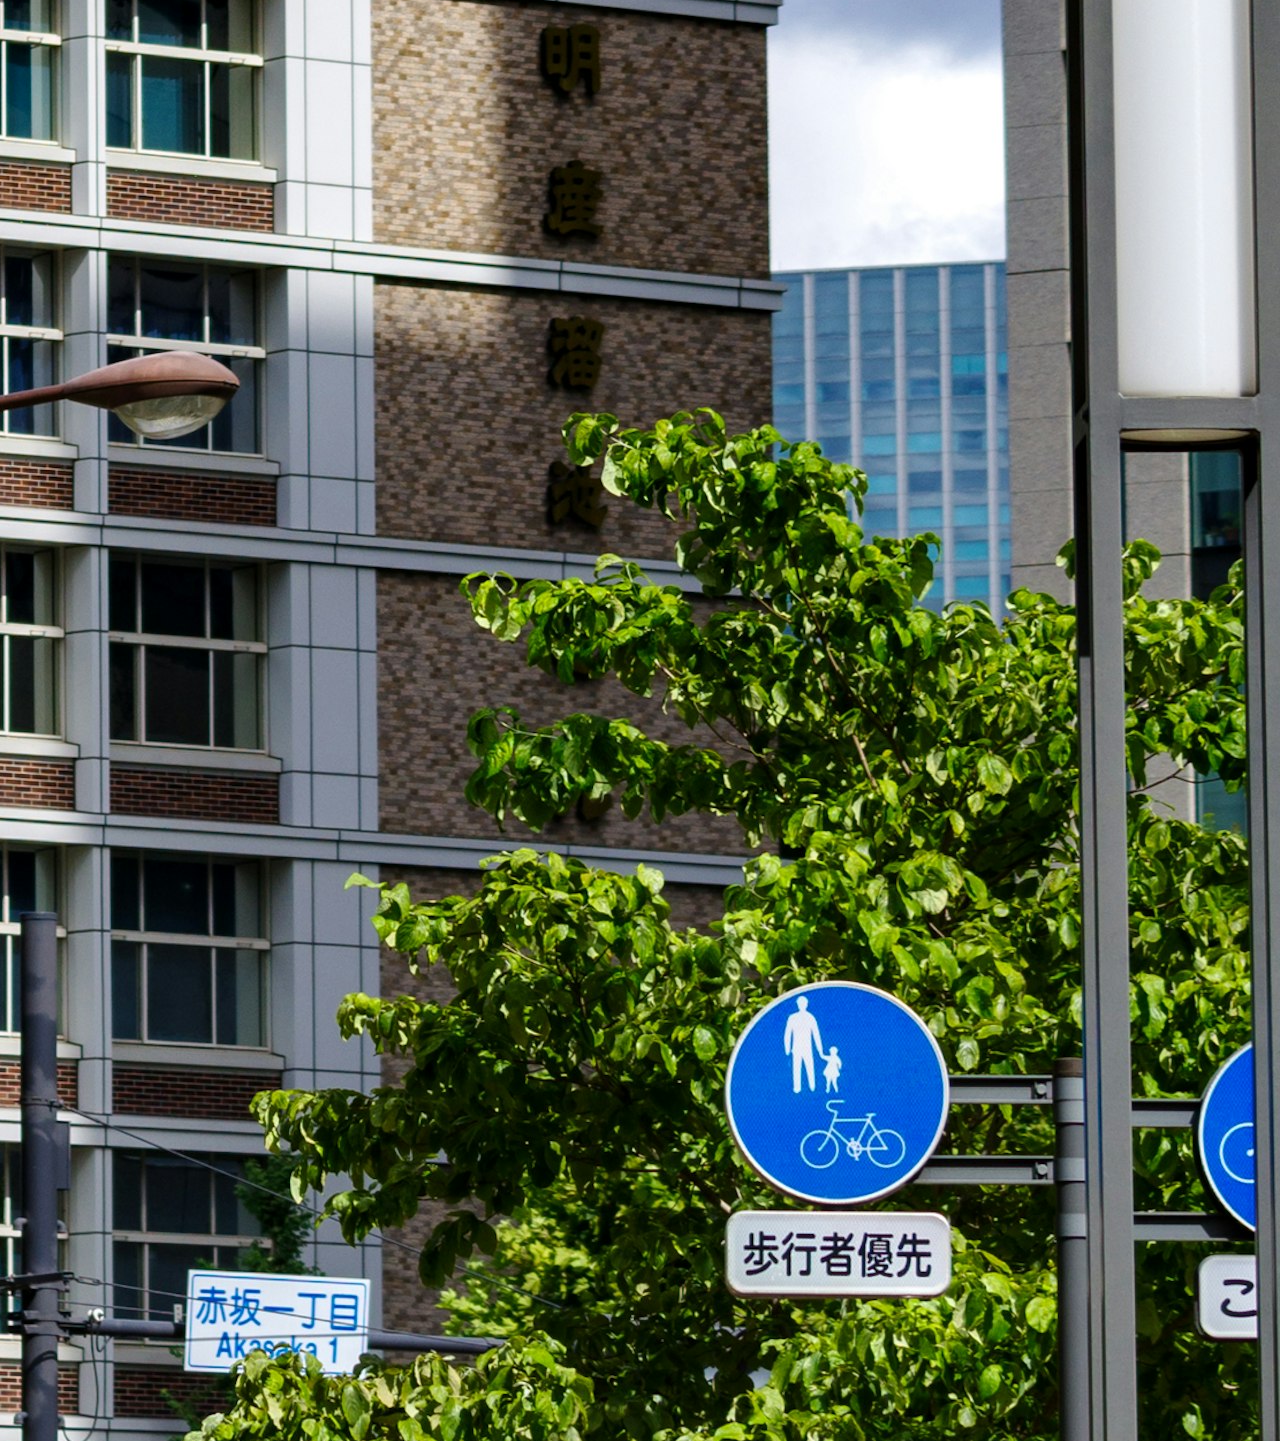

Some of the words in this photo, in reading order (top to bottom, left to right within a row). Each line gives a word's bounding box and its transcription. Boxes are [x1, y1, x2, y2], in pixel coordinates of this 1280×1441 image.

[743, 1230, 933, 1279] 歩行者優先
[195, 1285, 360, 1332] 赤坂一丁目
[328, 1336, 339, 1364] 1
